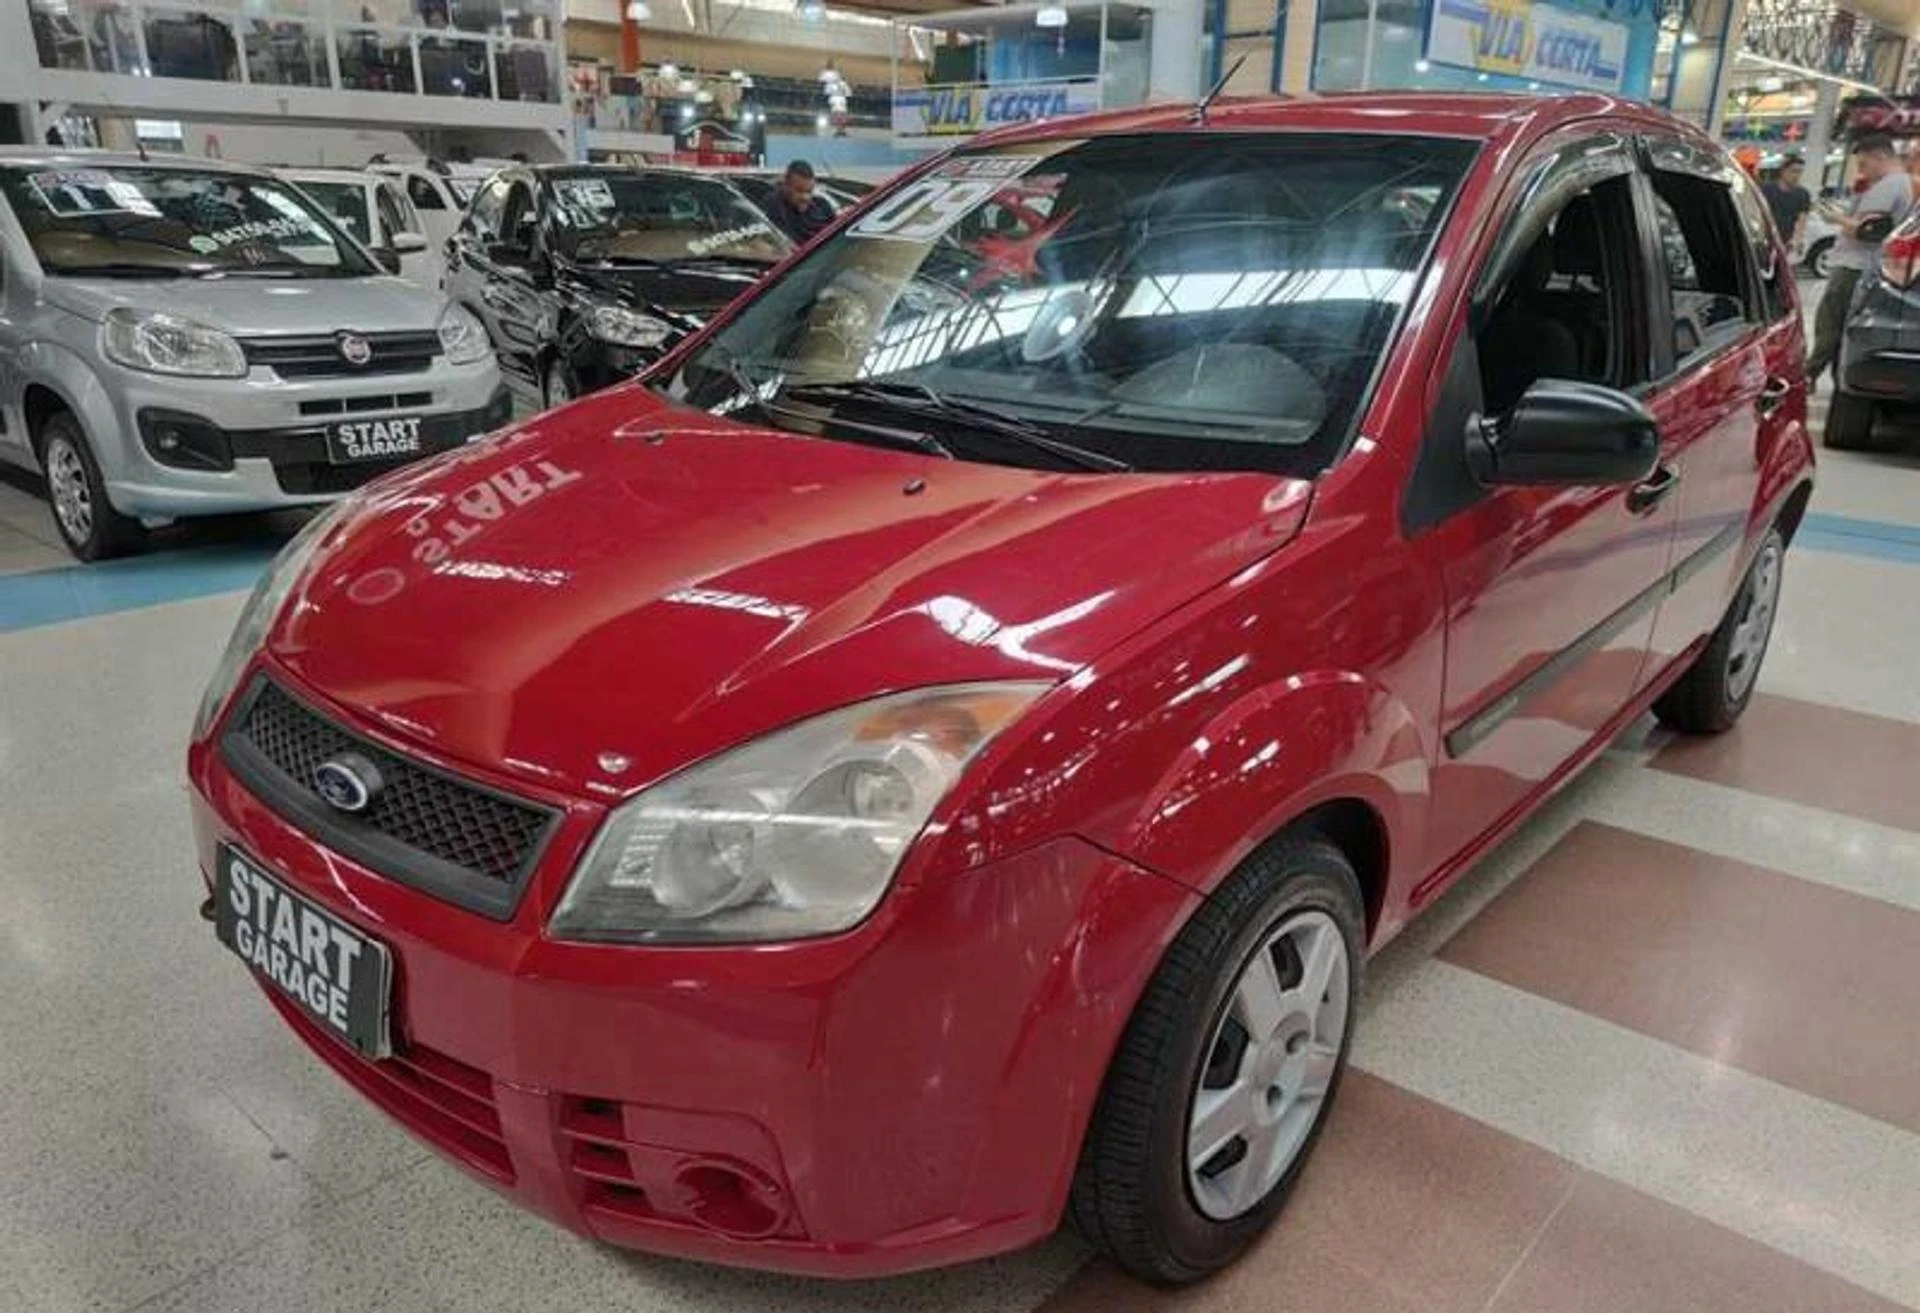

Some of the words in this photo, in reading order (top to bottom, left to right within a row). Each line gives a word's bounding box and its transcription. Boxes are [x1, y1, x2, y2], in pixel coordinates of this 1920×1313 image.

[1481, 12, 1526, 56] VIA
[931, 90, 971, 124] VIA
[338, 418, 421, 445] START
[347, 439, 421, 457] GARAGE
[229, 859, 361, 991] START
[235, 918, 349, 1031] GARAGE
